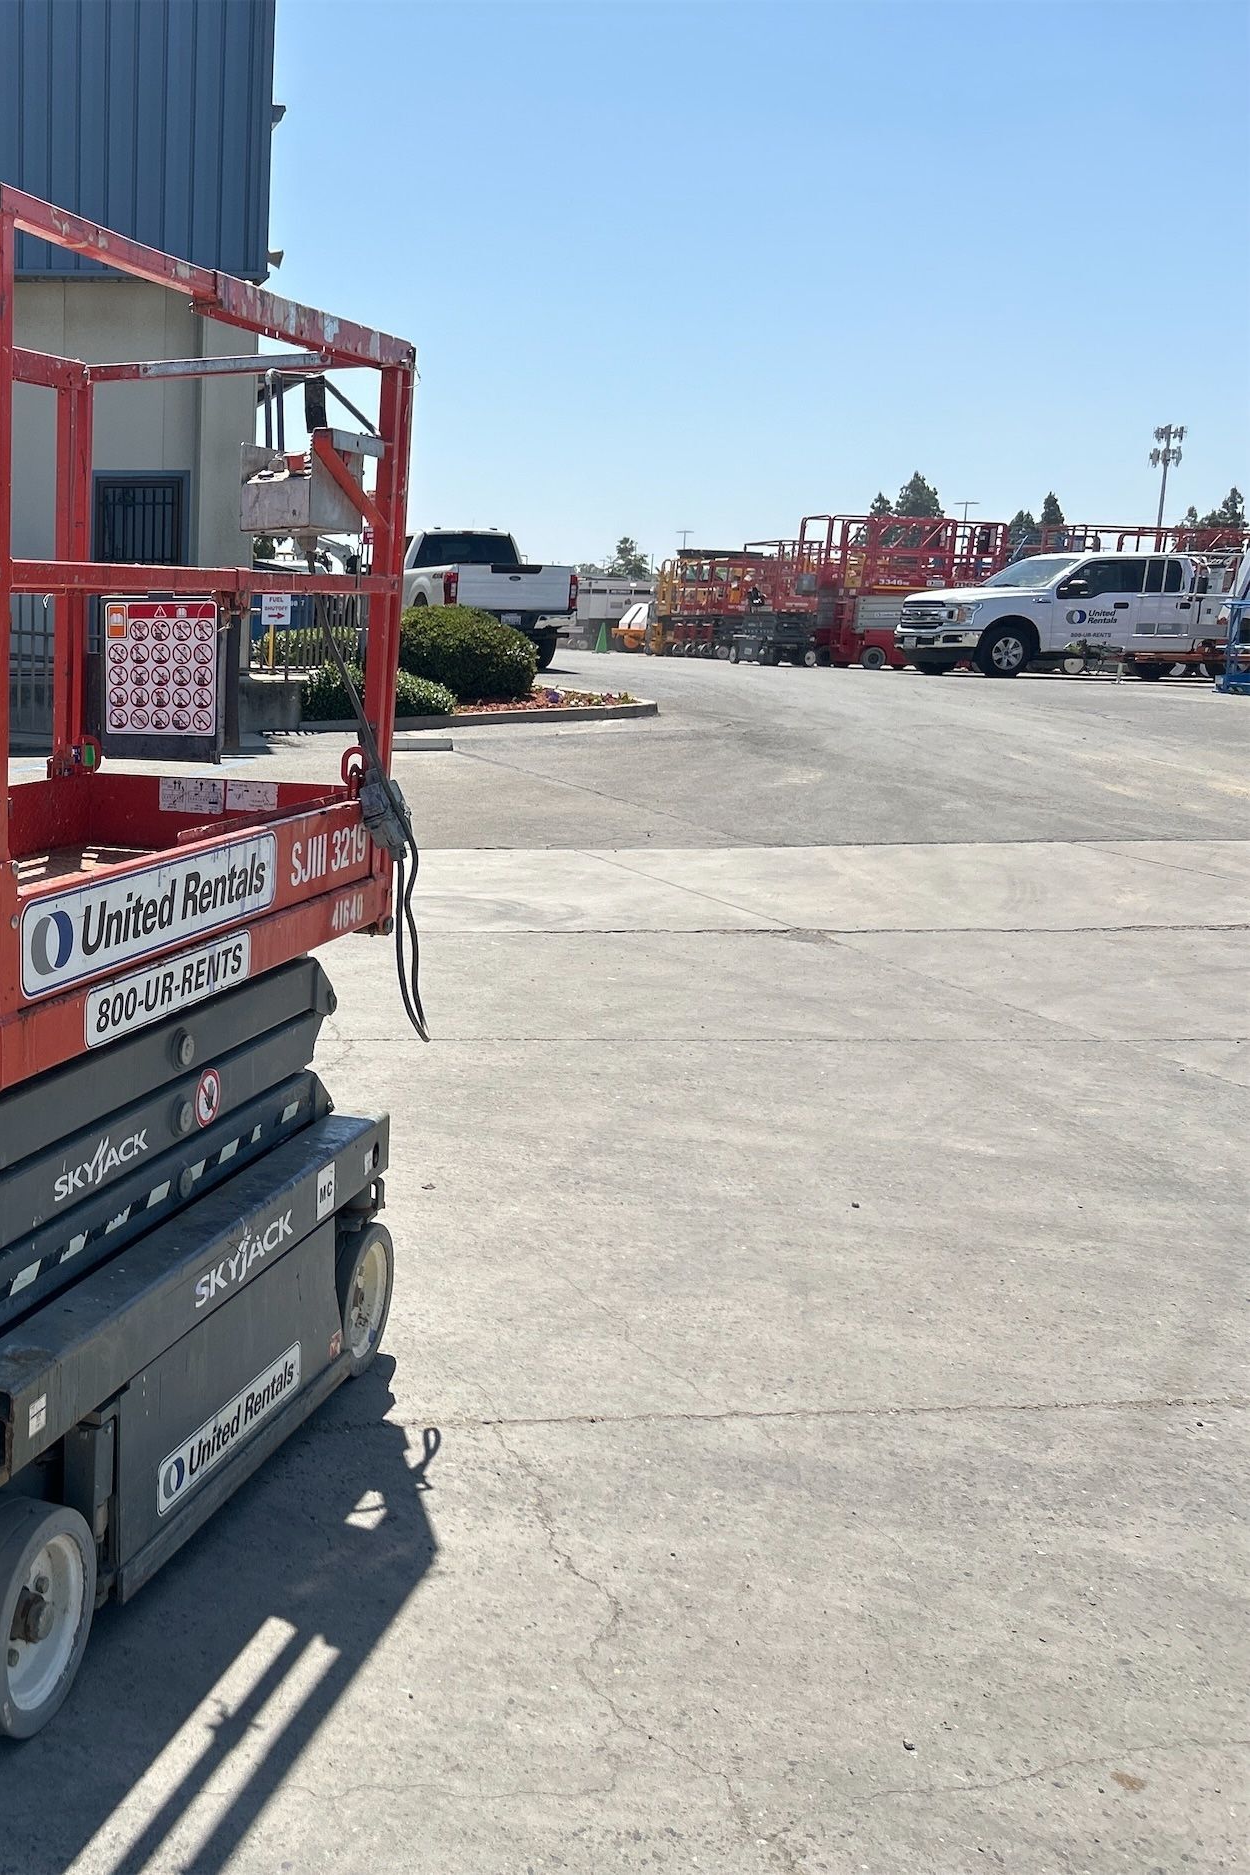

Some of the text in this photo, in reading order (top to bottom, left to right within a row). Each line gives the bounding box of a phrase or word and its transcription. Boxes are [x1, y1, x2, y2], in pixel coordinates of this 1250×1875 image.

[1088, 609, 1117, 617] United
[331, 823, 367, 872] 3219
[81, 852, 266, 956] United Rentals
[331, 893, 364, 931] 41640
[95, 944, 242, 1033] 800-UR-RENTS
[53, 1125, 149, 1202] SKYJACK
[194, 1209, 294, 1309] SKYJACK
[188, 1363, 296, 1476] United Rentals
